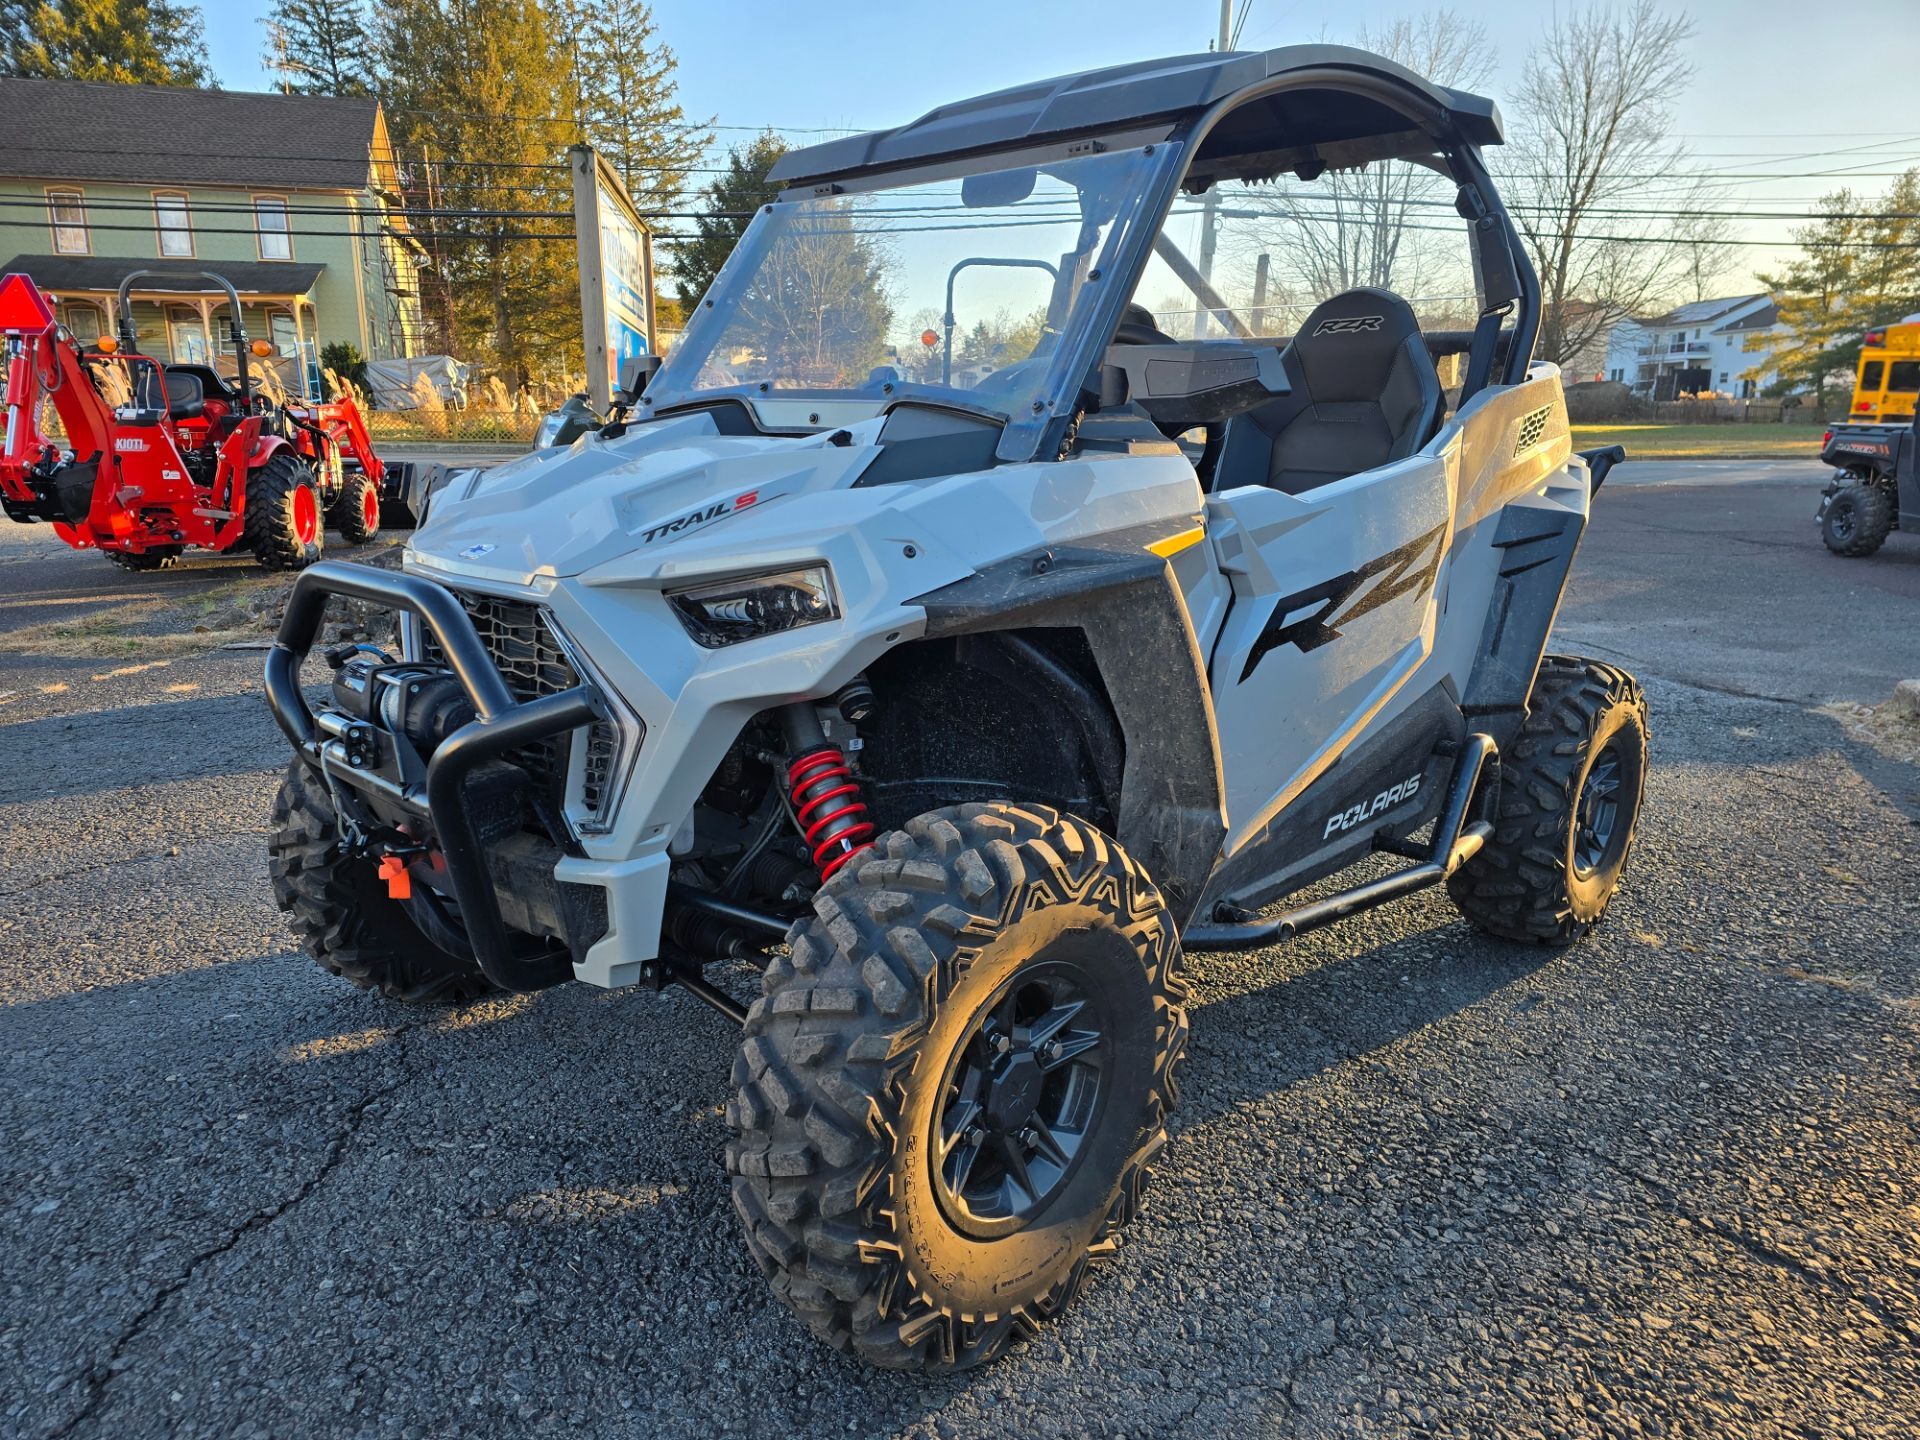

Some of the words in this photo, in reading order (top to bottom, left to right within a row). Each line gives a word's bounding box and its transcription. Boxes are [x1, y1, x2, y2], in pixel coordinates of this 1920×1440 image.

[1313, 316, 1384, 336] RZR
[115, 438, 143, 451] KIOTI
[641, 502, 731, 543] TRAIL
[734, 490, 759, 510] S
[1323, 773, 1422, 840] POLARIS
